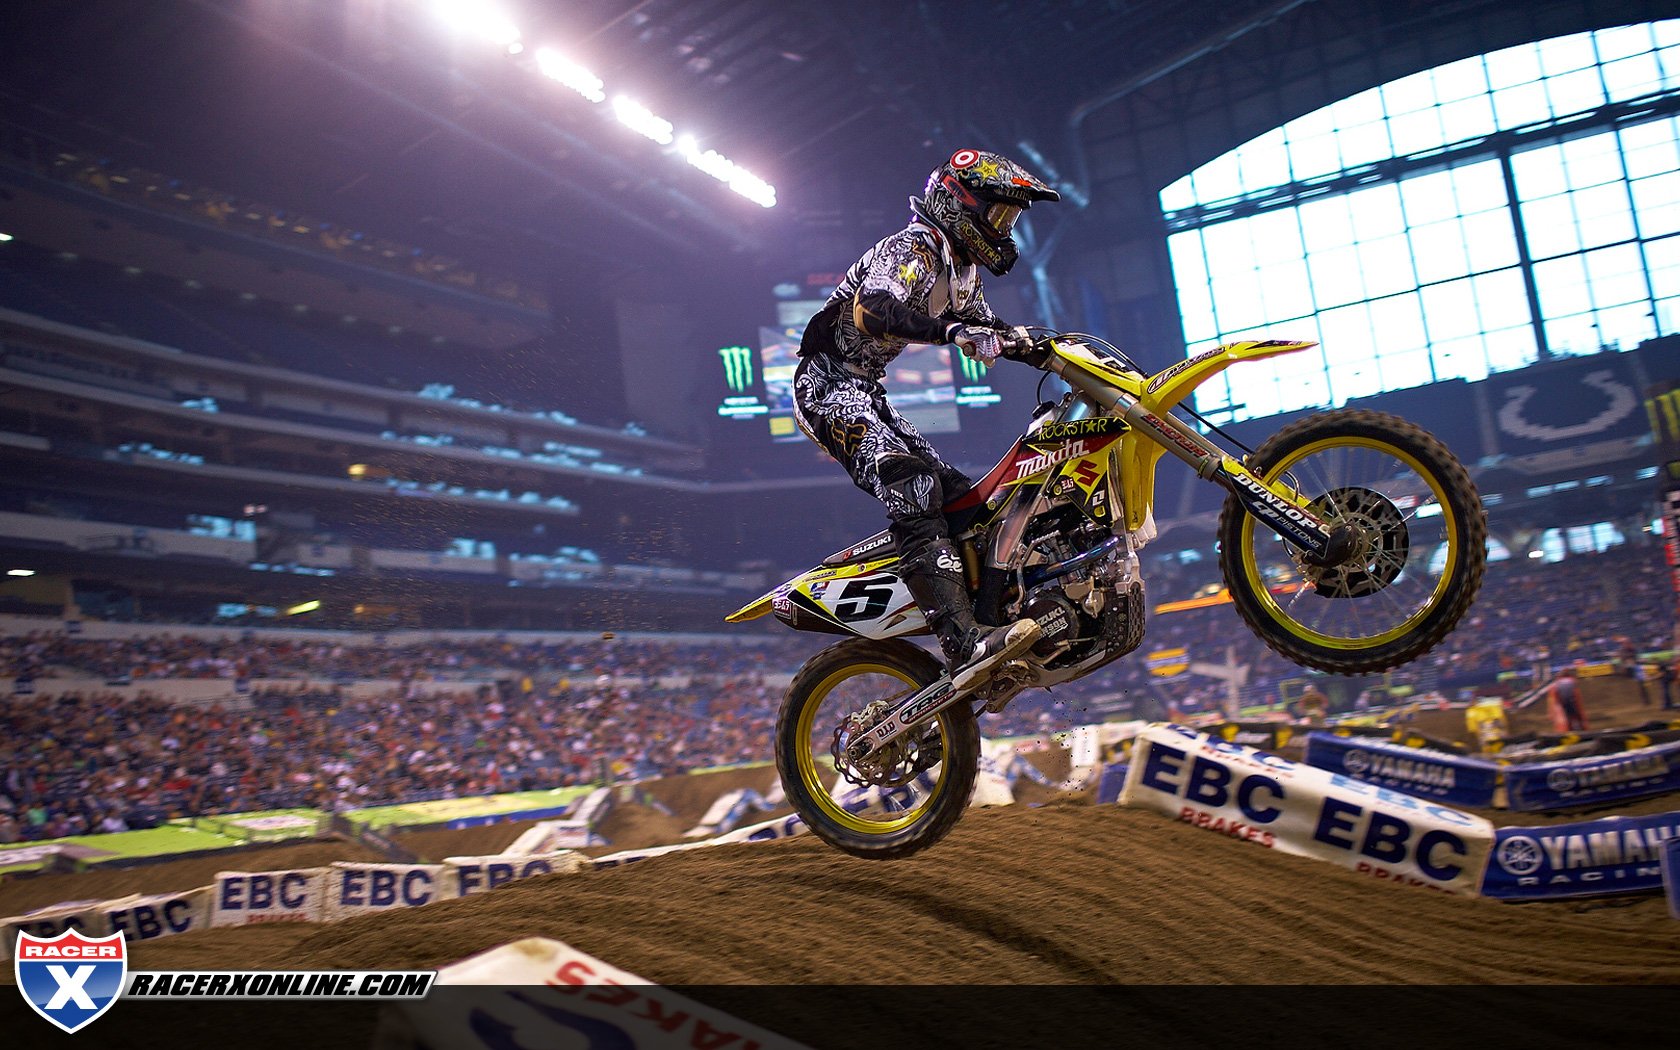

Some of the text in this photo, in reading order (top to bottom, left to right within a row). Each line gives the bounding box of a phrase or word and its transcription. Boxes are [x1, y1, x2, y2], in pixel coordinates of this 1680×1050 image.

[1015, 438, 1090, 479] makita
[1233, 473, 1317, 529] DUNLOP
[852, 535, 892, 556] SUZUKI
[1276, 516, 1323, 549] PISTONS
[834, 575, 899, 623] 5
[1141, 741, 1284, 824] EBC
[1370, 753, 1456, 788] YAMAHA
[1180, 806, 1276, 848] BRAKES
[1313, 796, 1466, 882] EBC
[1540, 825, 1680, 871] YAMAH
[220, 873, 306, 910] EBC
[340, 869, 432, 904] EBC
[1517, 866, 1662, 886] RACIN
[108, 898, 192, 941] EBC
